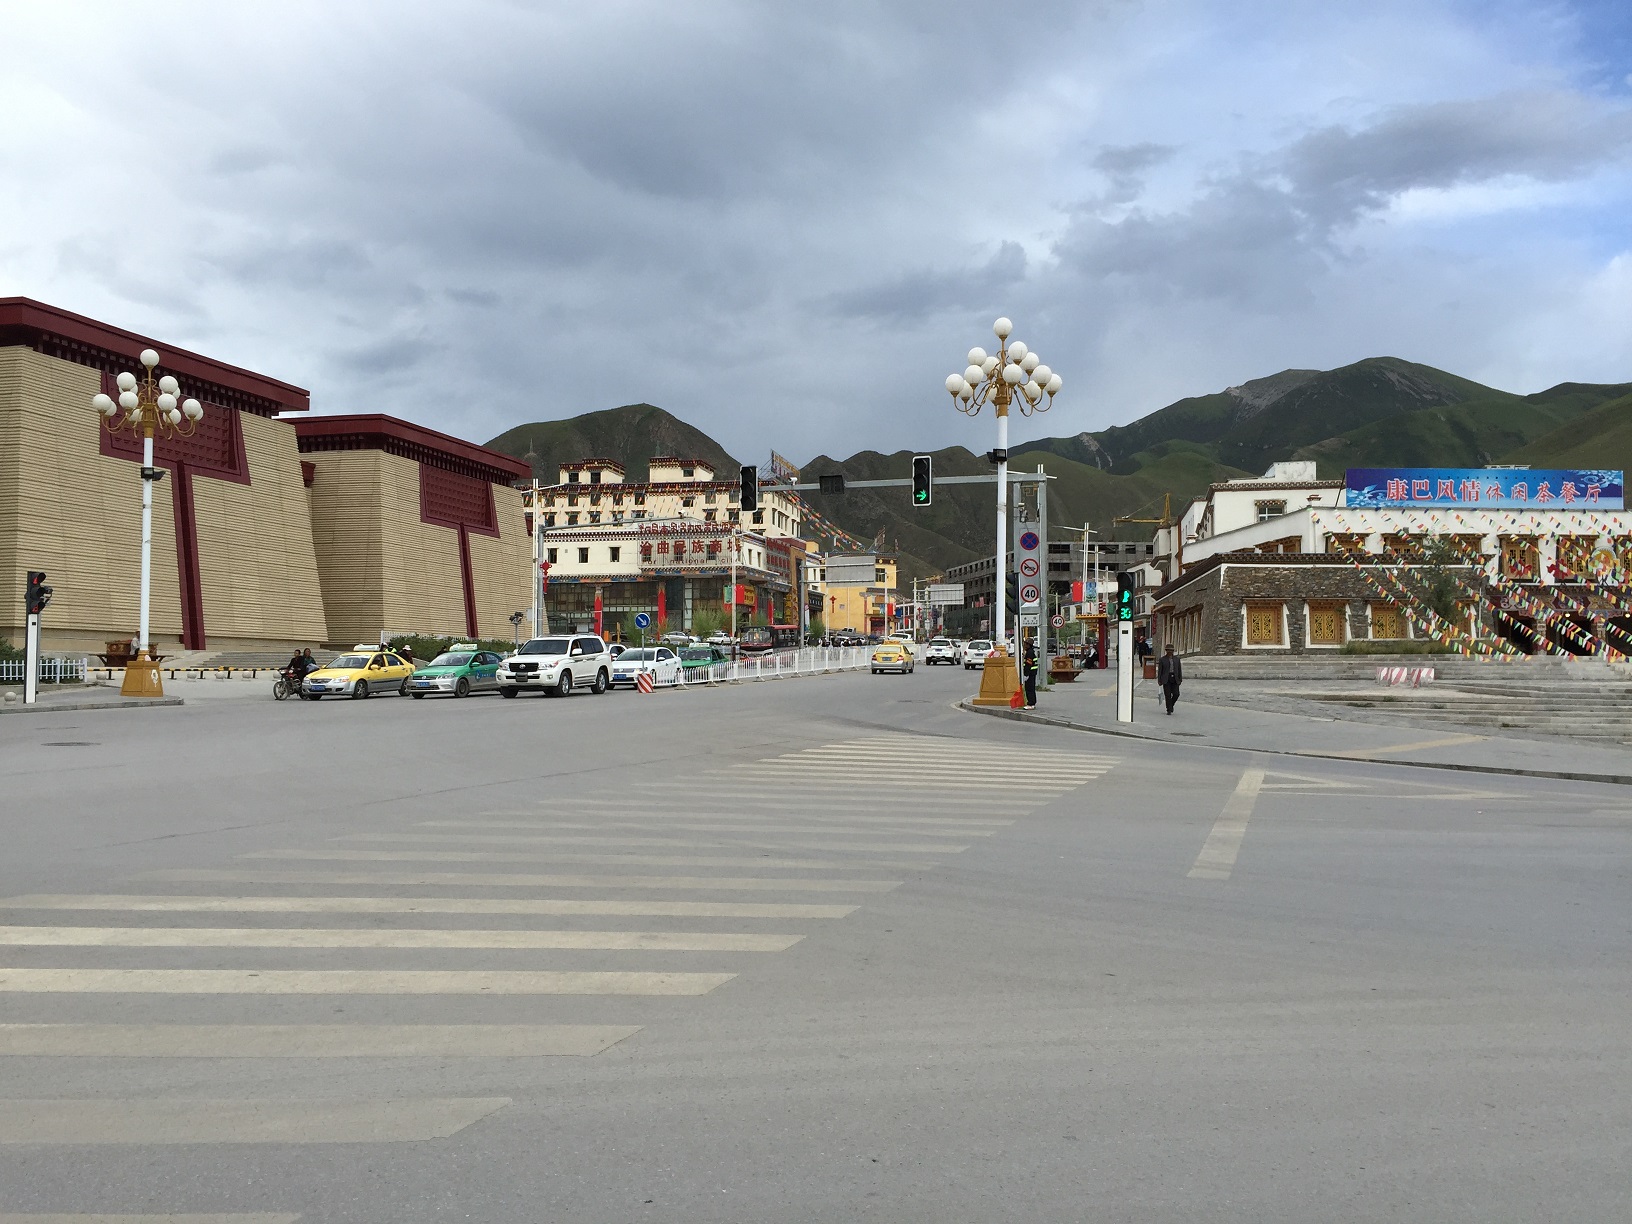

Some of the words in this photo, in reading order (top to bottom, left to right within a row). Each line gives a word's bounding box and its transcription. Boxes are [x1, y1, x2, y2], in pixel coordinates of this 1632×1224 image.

[1386, 478, 1602, 503] 康巴风情休闲茶餐厅
[1025, 590, 1036, 599] 40
